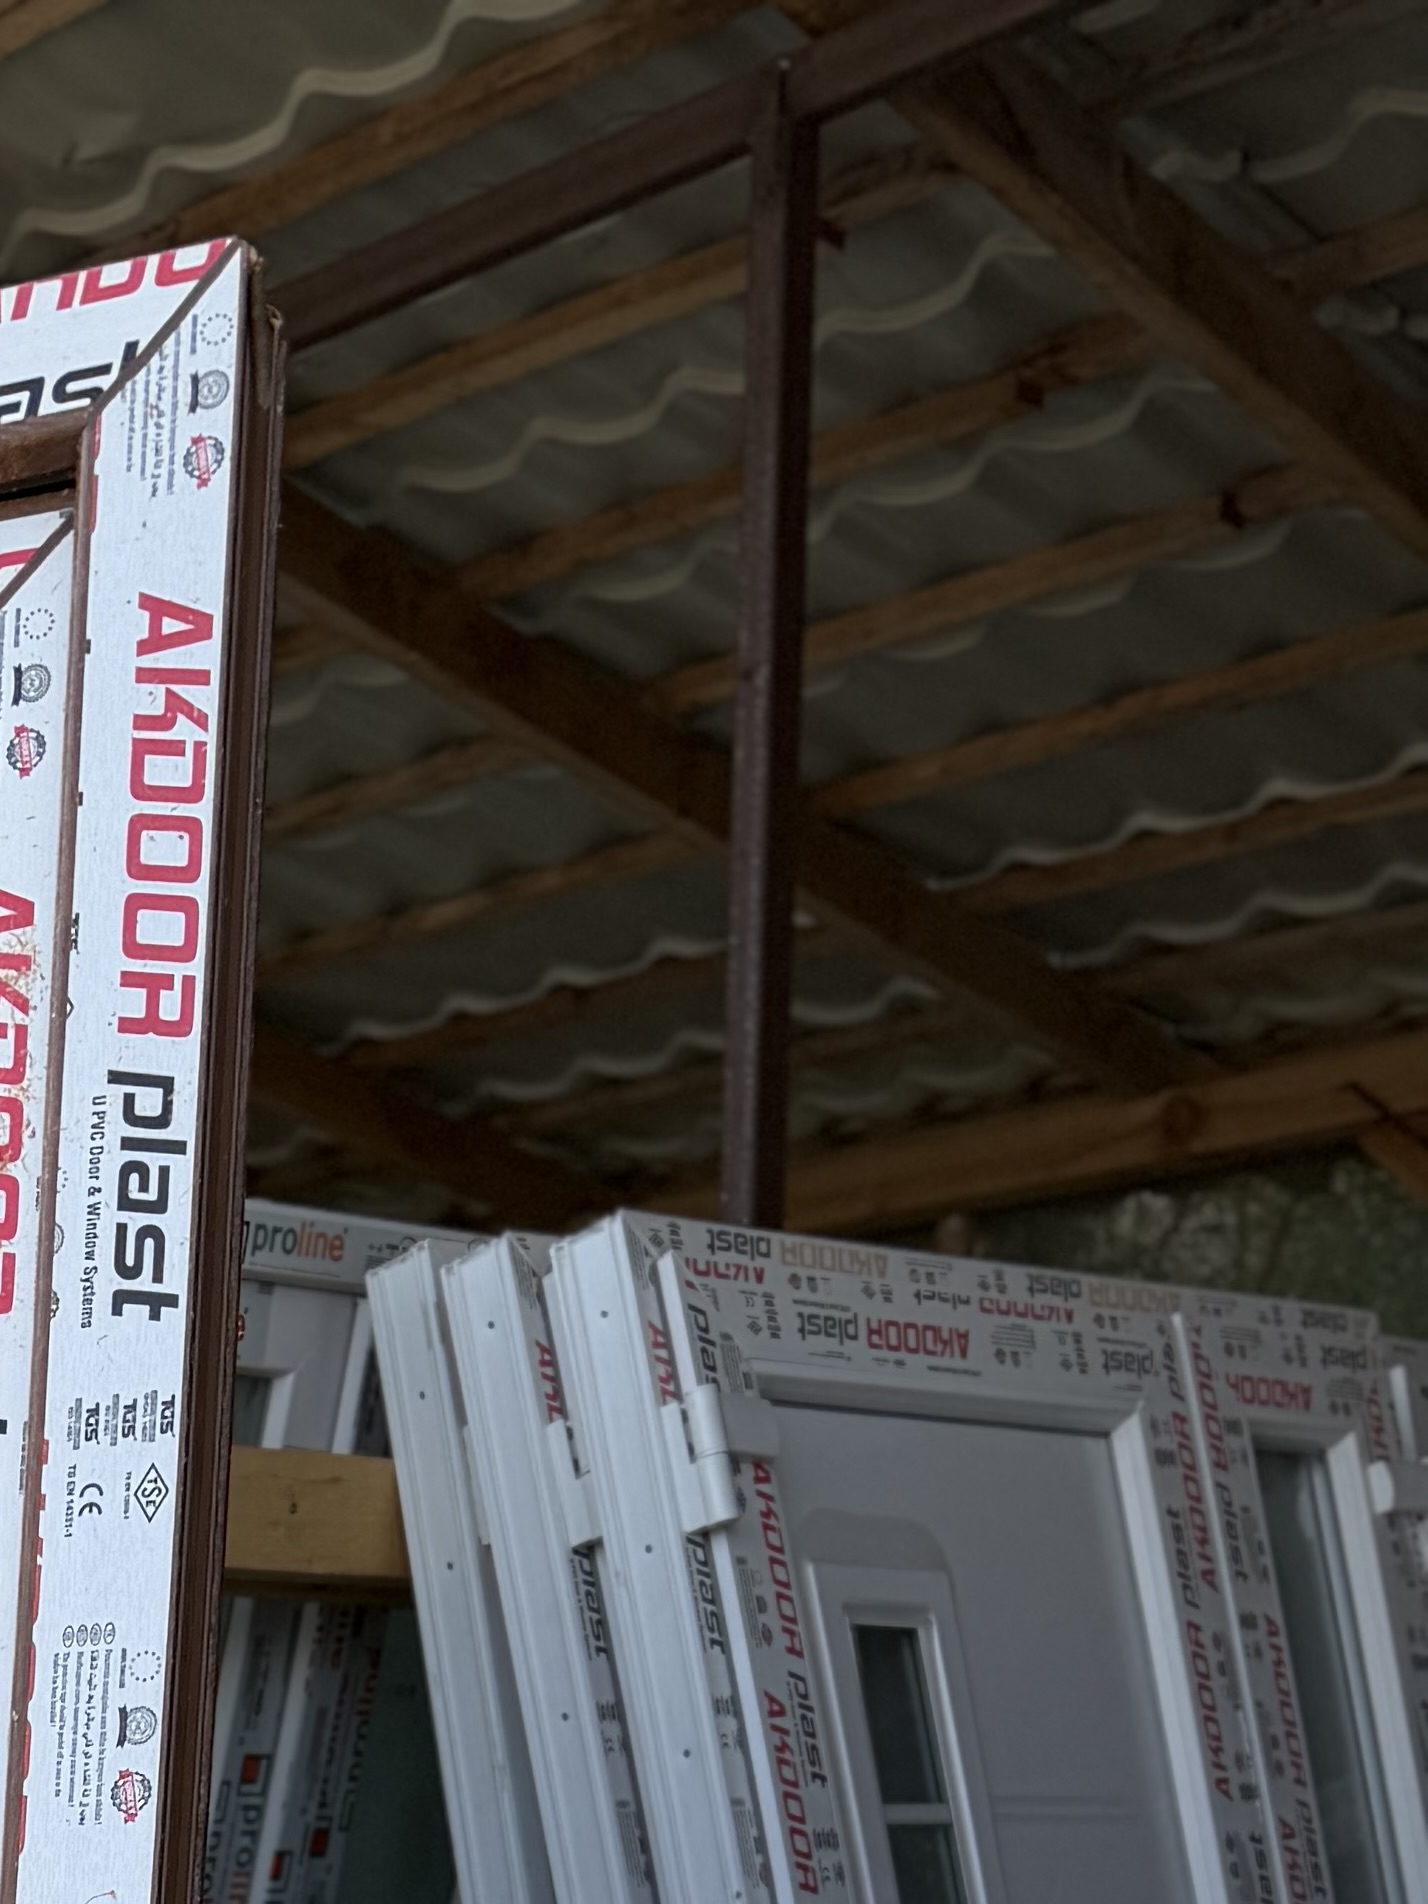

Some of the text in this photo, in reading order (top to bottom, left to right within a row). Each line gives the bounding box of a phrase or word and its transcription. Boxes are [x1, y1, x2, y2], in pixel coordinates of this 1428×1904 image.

[117, 592, 214, 1037] AKDOOR
[79, 1095, 107, 1329] U PVC Door & Window Systems
[106, 1069, 187, 1322] plast
[252, 1219, 346, 1265] proline
[796, 1309, 971, 1360] AKDOOR plast
[750, 1459, 828, 1787] AKDOOR plast
[763, 1692, 819, 1895] AKDOOR
